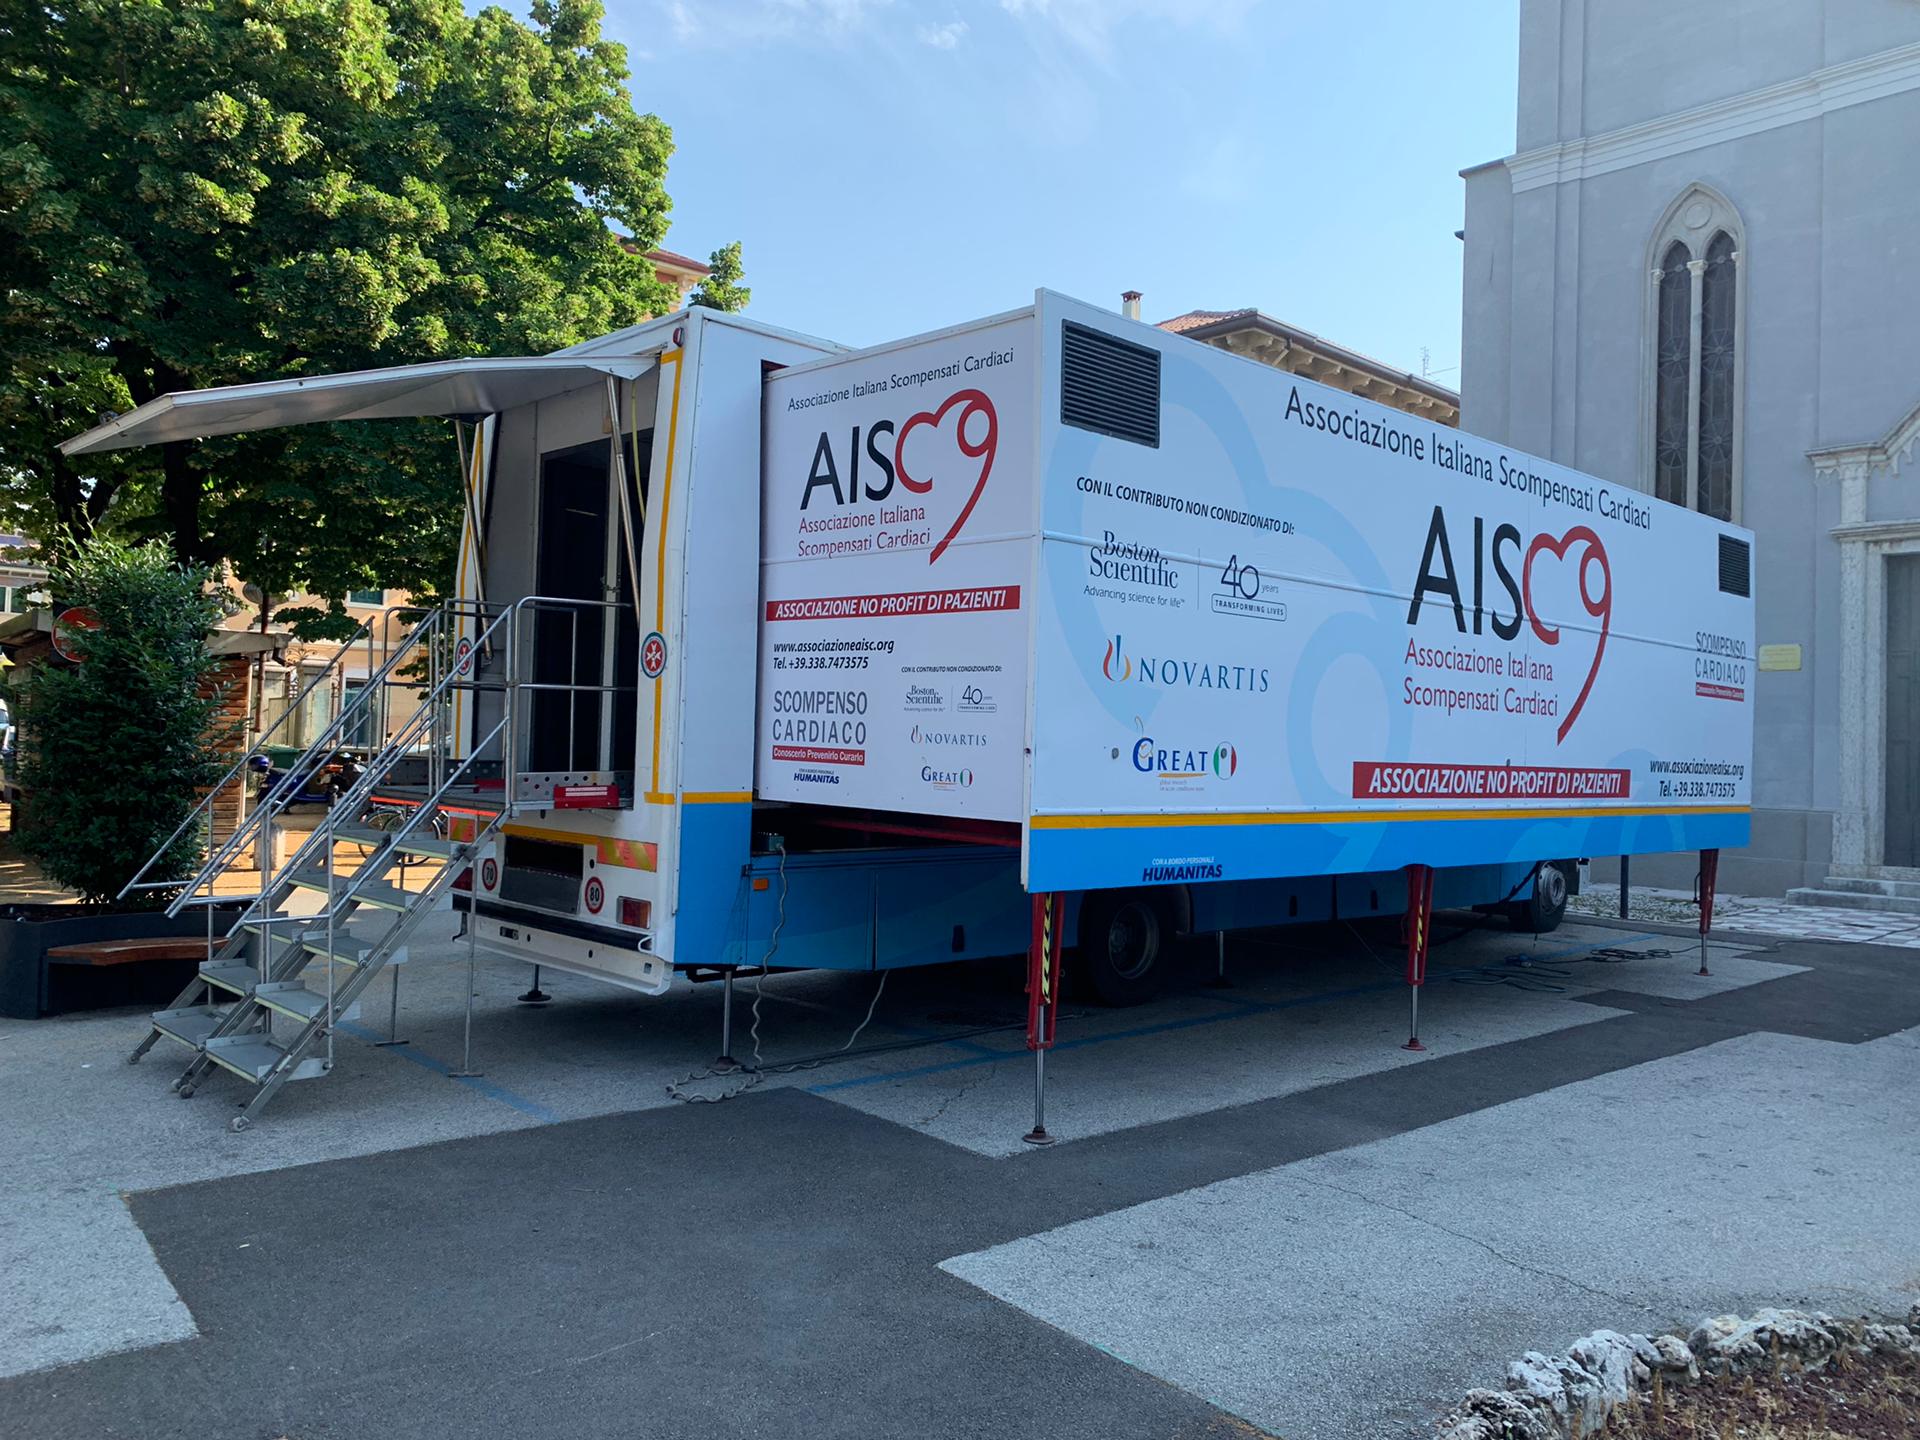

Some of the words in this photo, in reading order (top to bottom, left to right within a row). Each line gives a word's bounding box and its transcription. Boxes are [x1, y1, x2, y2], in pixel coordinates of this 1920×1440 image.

[788, 389, 849, 411] Associazione
[852, 381, 888, 399] Italiana
[890, 362, 960, 389] Scompensati
[964, 348, 1014, 372] Cardiaci
[1284, 385, 1425, 461] Associazione
[1431, 432, 1494, 483] Italiana
[1499, 454, 1594, 512] Scompensati
[1598, 488, 1652, 530] Cardiaci
[1076, 476, 1103, 495] CON
[1103, 482, 1114, 497] IL
[1115, 485, 1184, 513] CONTRIBUTO
[1185, 501, 1209, 518] NON
[1210, 506, 1281, 533] CONDIZIONATO
[1282, 521, 1295, 535] DI:
[798, 510, 876, 534] Associazione
[879, 506, 926, 526] Italiana
[798, 535, 873, 559] Scompensati
[876, 528, 931, 549] Cardiaci
[1103, 530, 1160, 563] Boston
[1089, 546, 1179, 589] Scientific
[1221, 554, 1260, 599] 40
[775, 599, 857, 619] ASSOCIAZIONE
[858, 598, 879, 615] NO
[879, 595, 926, 614] PROFIT
[926, 594, 943, 611] DI
[943, 589, 1007, 610] PAZIENTI
[1083, 584, 1127, 603] Advancing
[1128, 591, 1157, 605] science
[1157, 595, 1168, 606] for
[1214, 599, 1265, 614] TRANSFORMING
[1266, 606, 1284, 616] LIVES
[773, 638, 895, 654] www.associazioneaisc.org
[1404, 637, 1503, 676] Associazione
[1507, 651, 1554, 681] Italiana
[773, 657, 788, 670] Tel.
[788, 656, 869, 670] +39.338.7473575
[1138, 657, 1269, 693] NOVARTIS
[1695, 657, 1746, 685] CARDIACO
[773, 690, 868, 715] SCOMPENSO
[962, 685, 983, 705] 40
[1403, 677, 1500, 716] Scompensati
[1503, 687, 1559, 716] Cardiaci
[772, 719, 867, 745] CARDIACO
[925, 732, 987, 747] NOVARTIS
[793, 772, 840, 785] HUMANITAS
[1368, 767, 1484, 794] ASSOCIAZIONE
[1486, 770, 1508, 794] NO
[1509, 771, 1556, 794] PROFIT
[1556, 772, 1570, 794] DI
[1569, 772, 1622, 794] PAZIENTI
[1649, 757, 1745, 781] www.associazioneaisc.org
[1659, 780, 1672, 797] Tel.
[1673, 781, 1736, 798] +39.338.7473575
[486, 866, 494, 881] 70
[1142, 863, 1223, 882] HUMANITAS
[589, 886, 600, 902] 80
